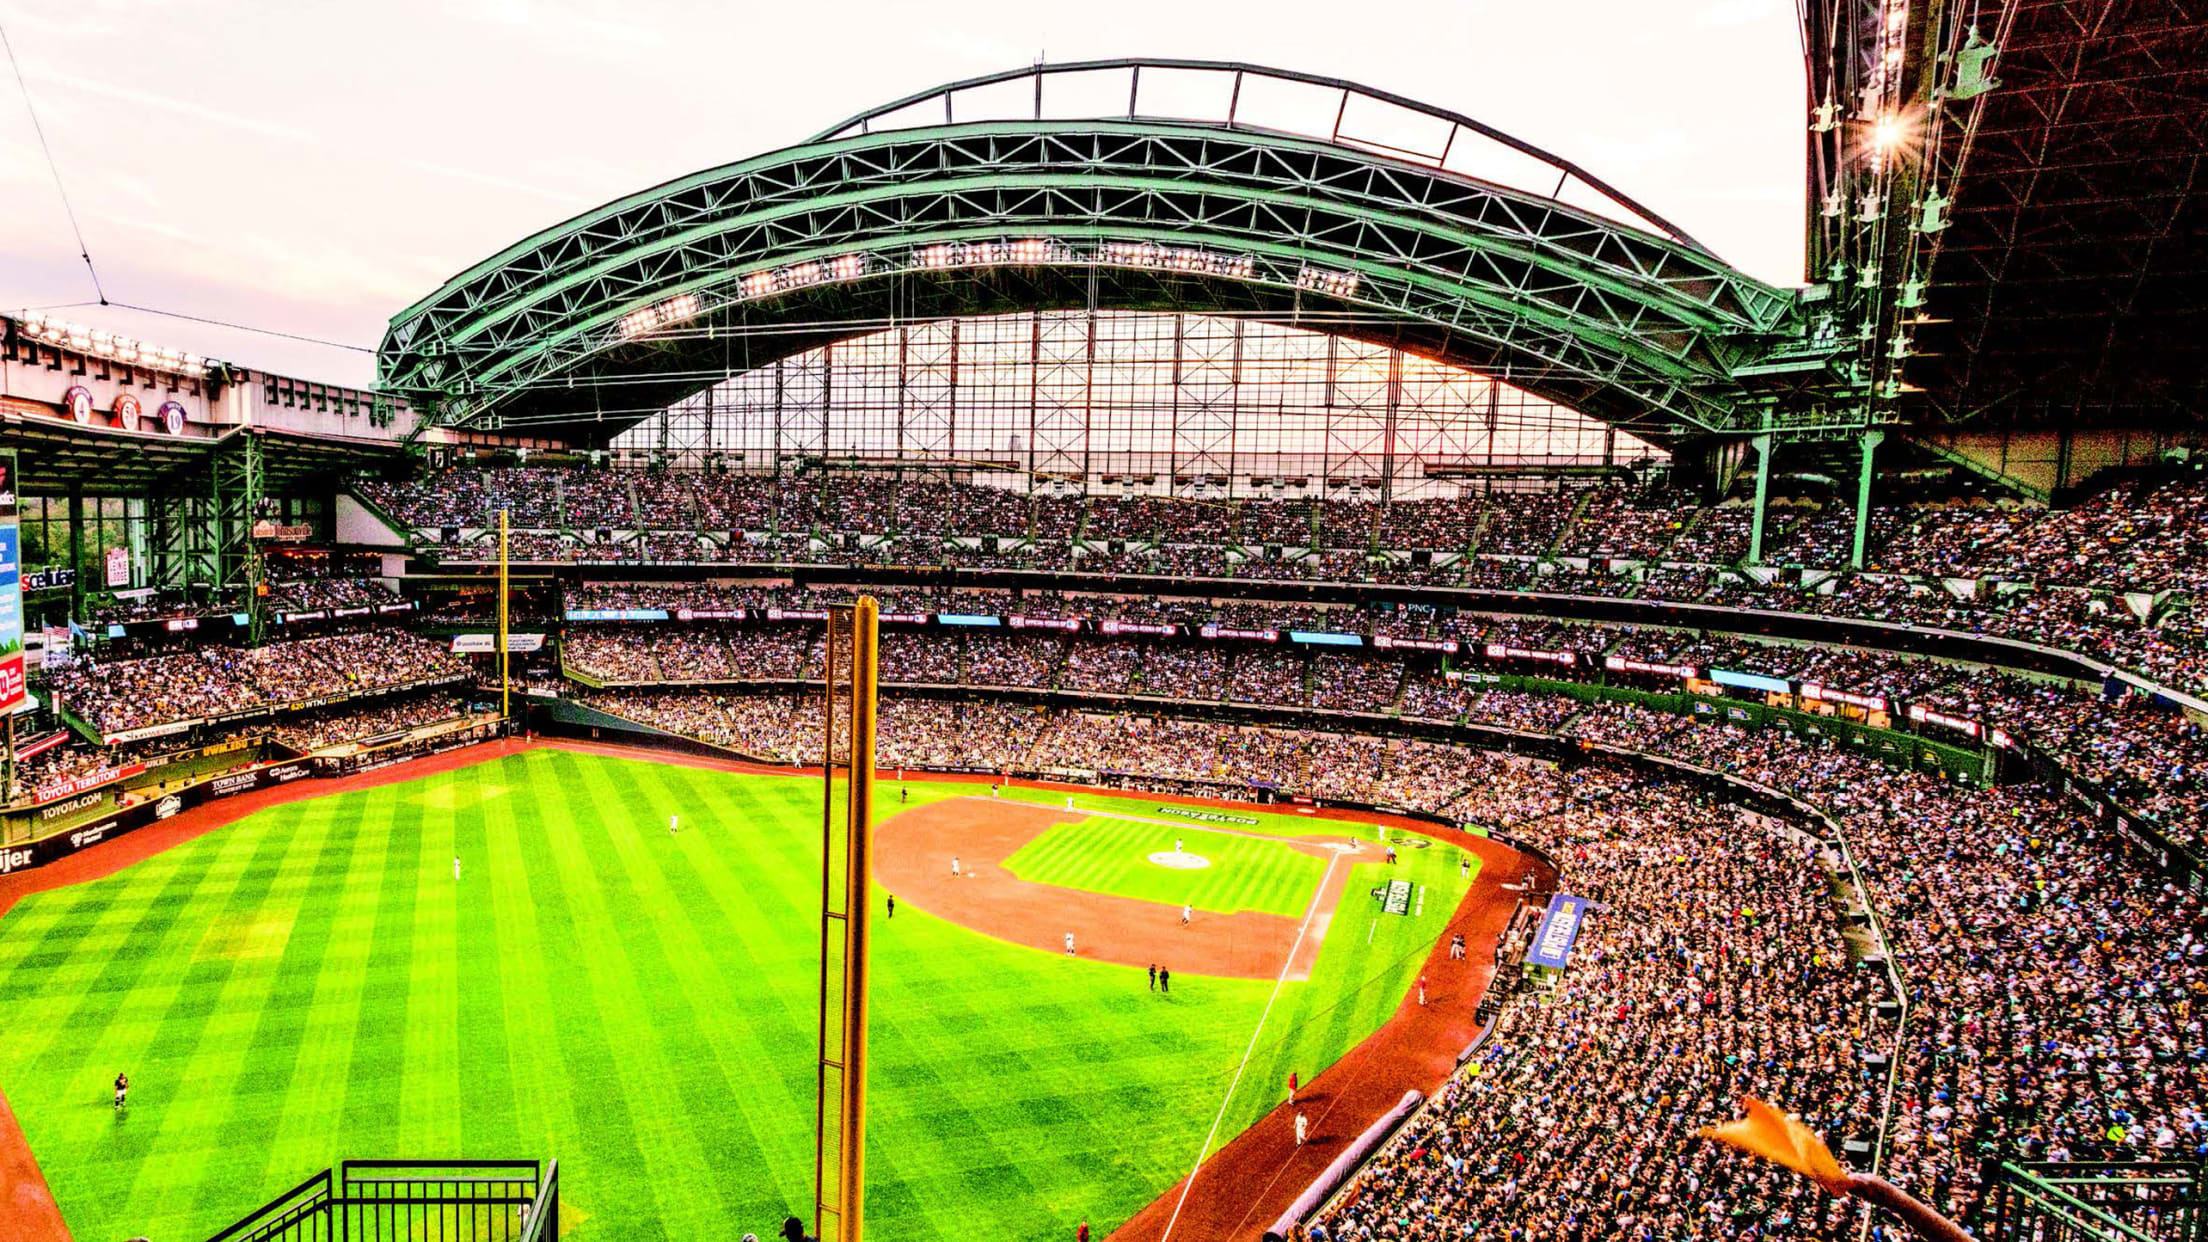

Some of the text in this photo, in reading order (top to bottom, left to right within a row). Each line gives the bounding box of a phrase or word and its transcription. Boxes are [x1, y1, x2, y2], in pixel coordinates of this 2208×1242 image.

[170, 414, 181, 431] 19
[21, 566, 75, 591] scellular
[1408, 603, 1430, 613] PNC
[291, 701, 305, 711] 620
[305, 698, 327, 708] WTMJ
[203, 739, 248, 757] UWM.EDU
[38, 769, 121, 802] TOYOTA TERRITORY
[211, 771, 257, 791] TOWN BANK
[42, 792, 102, 819] TOYOTA.COM
[1159, 807, 1258, 825] POSTSEASON
